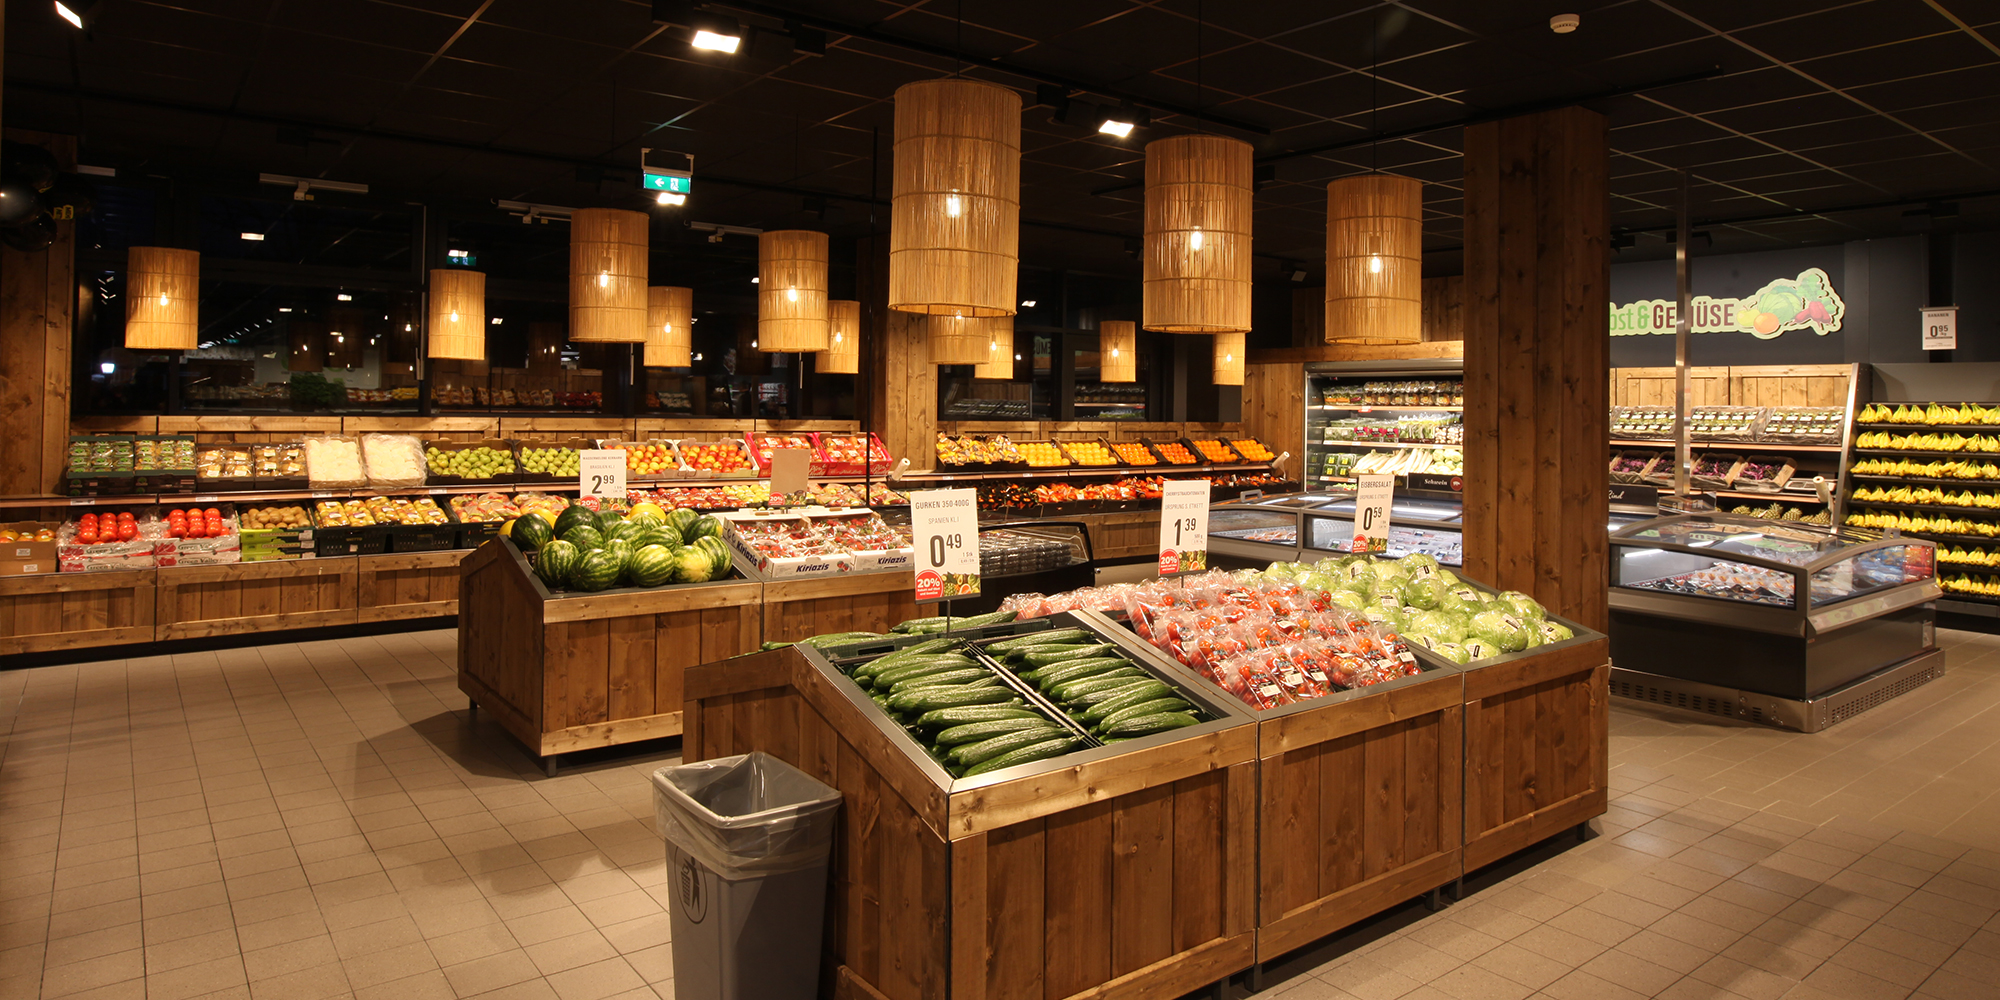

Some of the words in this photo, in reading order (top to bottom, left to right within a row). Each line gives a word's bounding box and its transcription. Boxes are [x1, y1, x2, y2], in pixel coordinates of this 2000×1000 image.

[1609, 306, 1634, 331] bst
[1653, 300, 1734, 330] GEÜSE
[915, 500, 940, 510] GURKEN
[736, 540, 758, 567] Kiriazis
[200, 557, 219, 565] Valley
[877, 555, 907, 565] Kiriazis
[1161, 555, 1177, 564] 20%
[796, 563, 829, 573] Kiriazis
[917, 578, 940, 588] 20%
